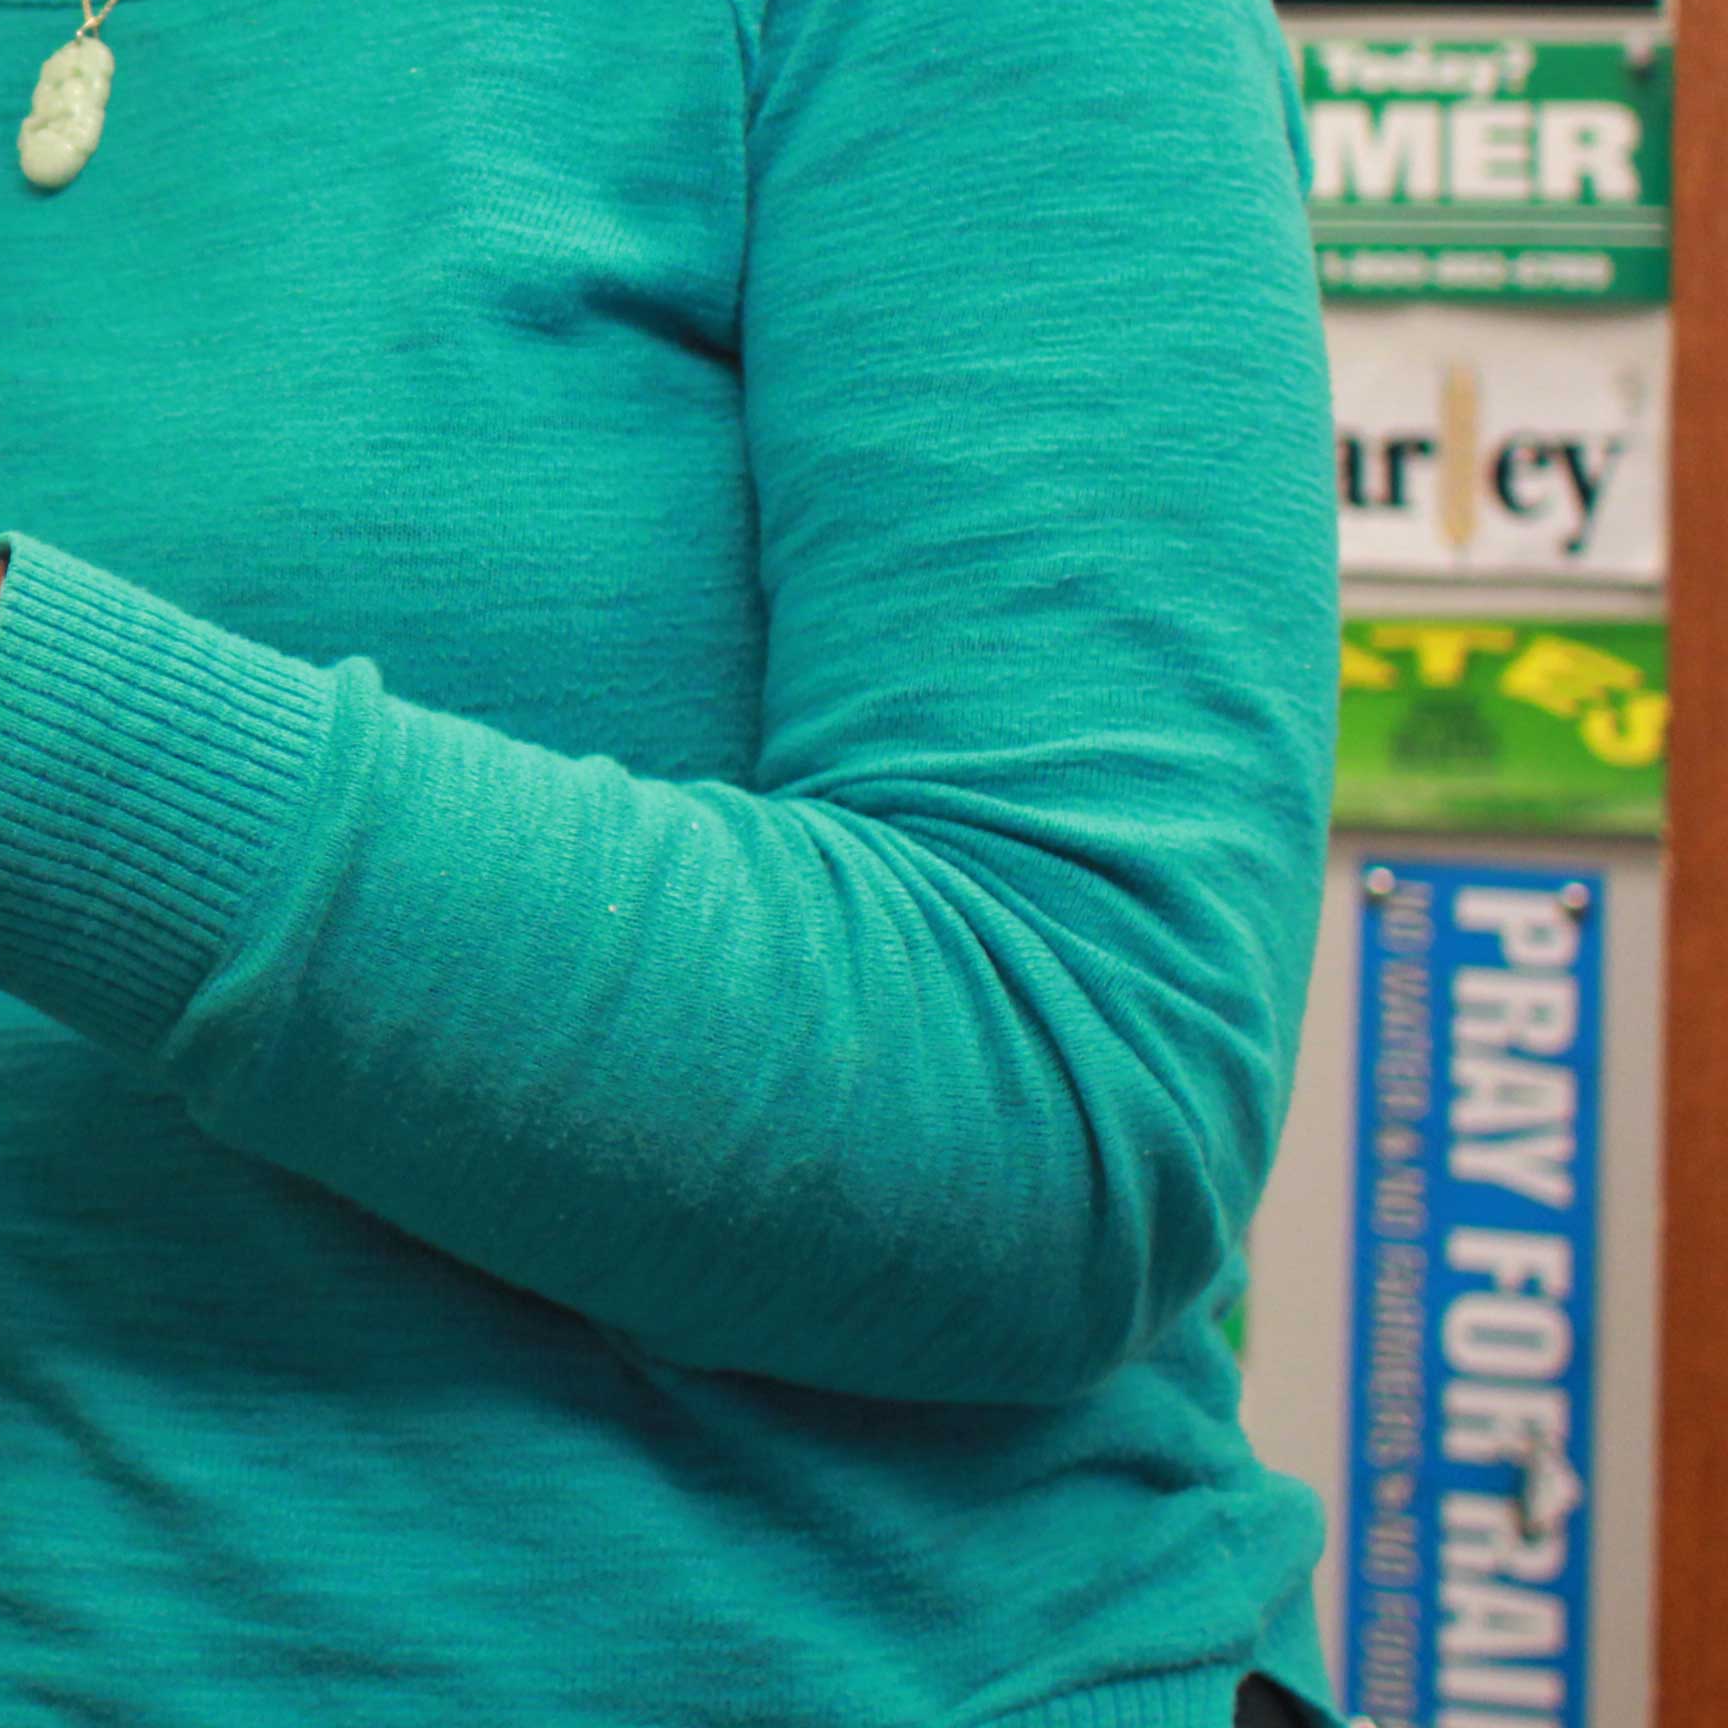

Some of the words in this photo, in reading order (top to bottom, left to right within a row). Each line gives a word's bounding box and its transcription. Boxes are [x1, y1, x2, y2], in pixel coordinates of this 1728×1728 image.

[1321, 34, 1535, 96] Today?
[1450, 884, 1579, 1210] PRAY
[1442, 1224, 1575, 1465] FOR
